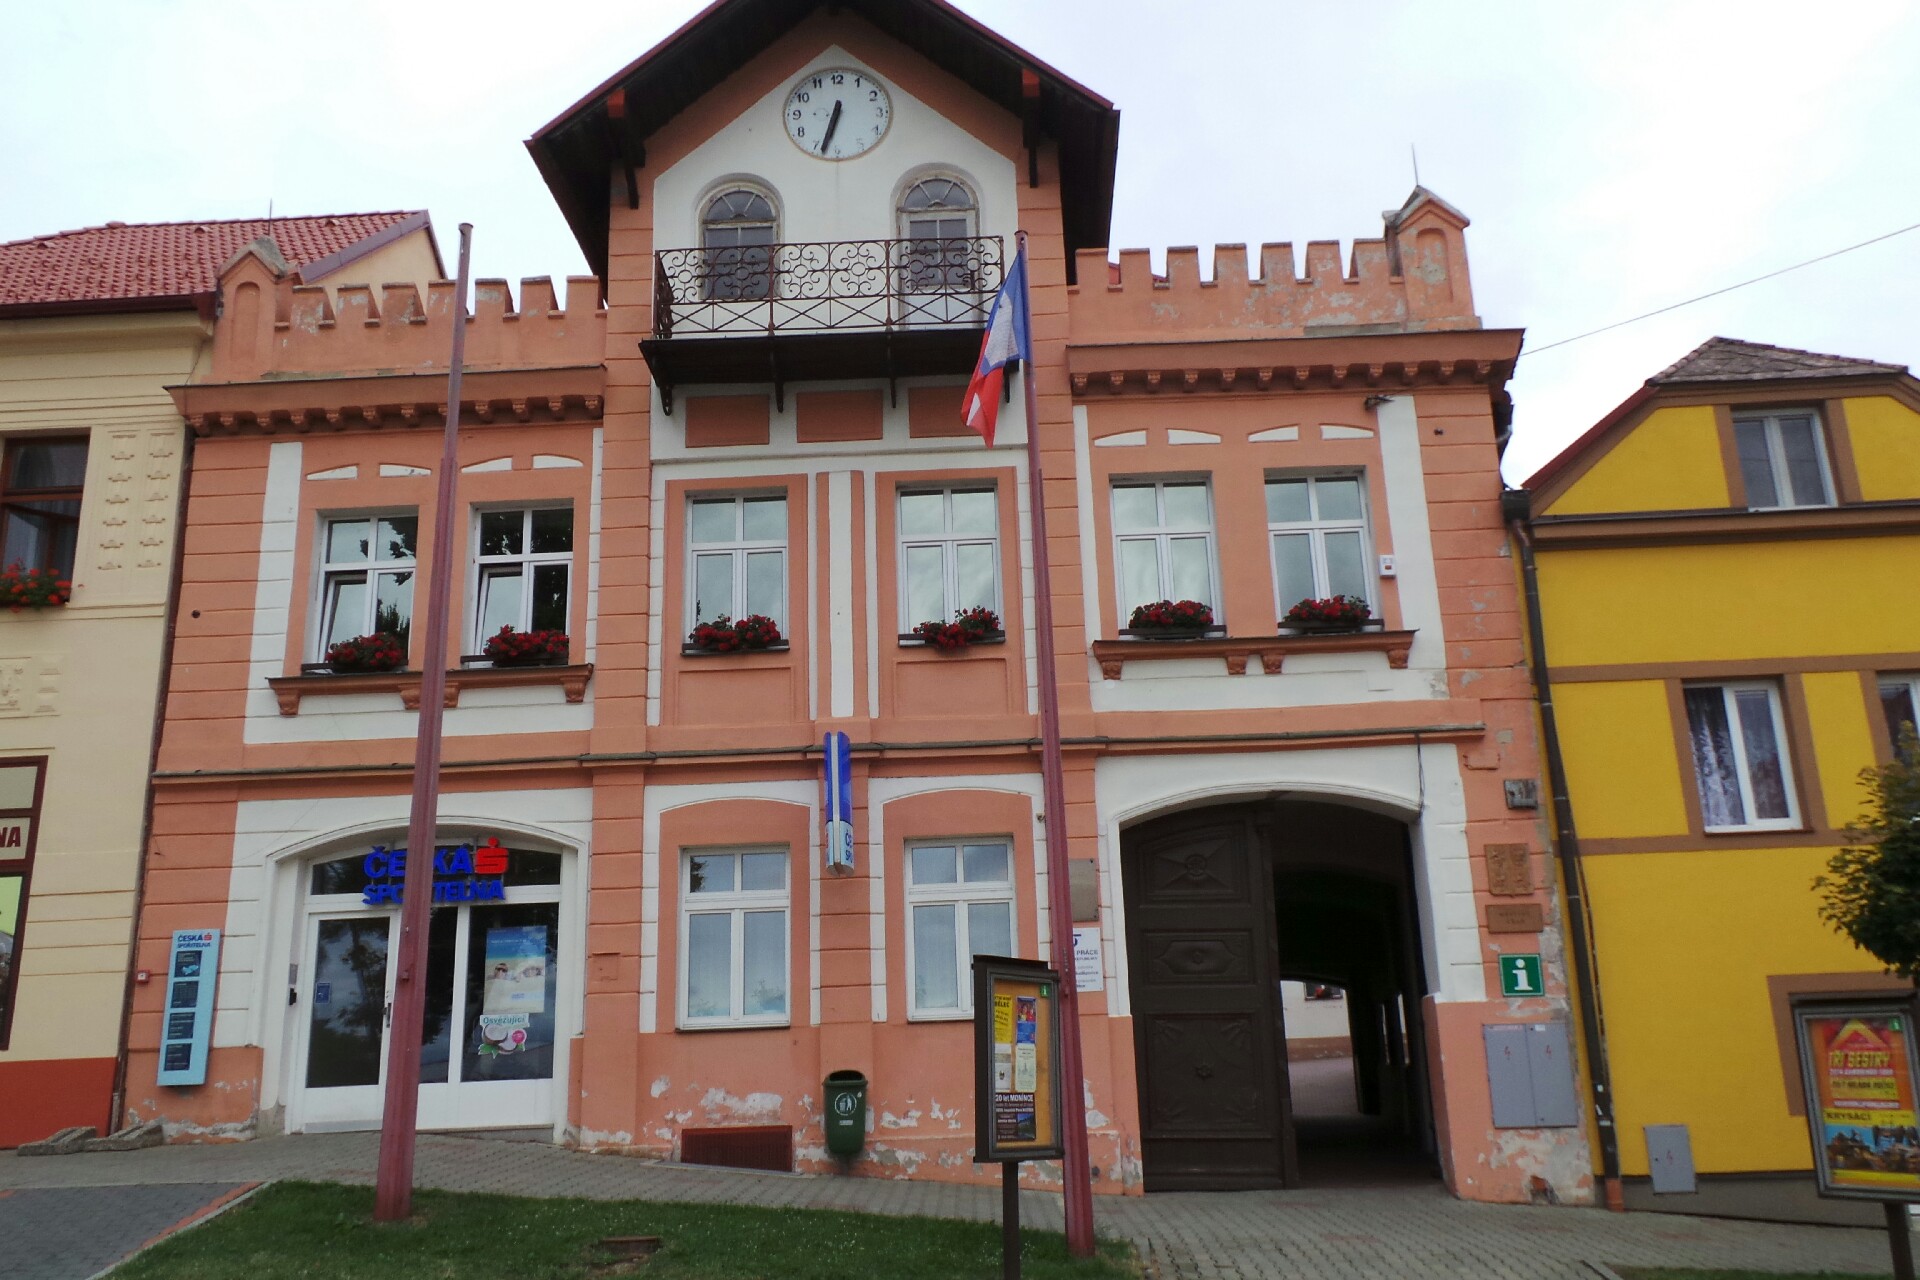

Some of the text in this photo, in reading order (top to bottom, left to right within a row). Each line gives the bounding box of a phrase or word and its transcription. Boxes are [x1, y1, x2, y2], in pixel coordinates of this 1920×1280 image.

[812, 78, 822, 88] 11
[831, 75, 844, 85] 12
[855, 76, 861, 88] 1
[798, 92, 809, 102] 10
[869, 91, 878, 102] 2
[792, 109, 802, 120] 9
[797, 127, 805, 137] 8
[363, 843, 472, 877] ČEKÁ
[362, 880, 506, 905] SPOTELNA
